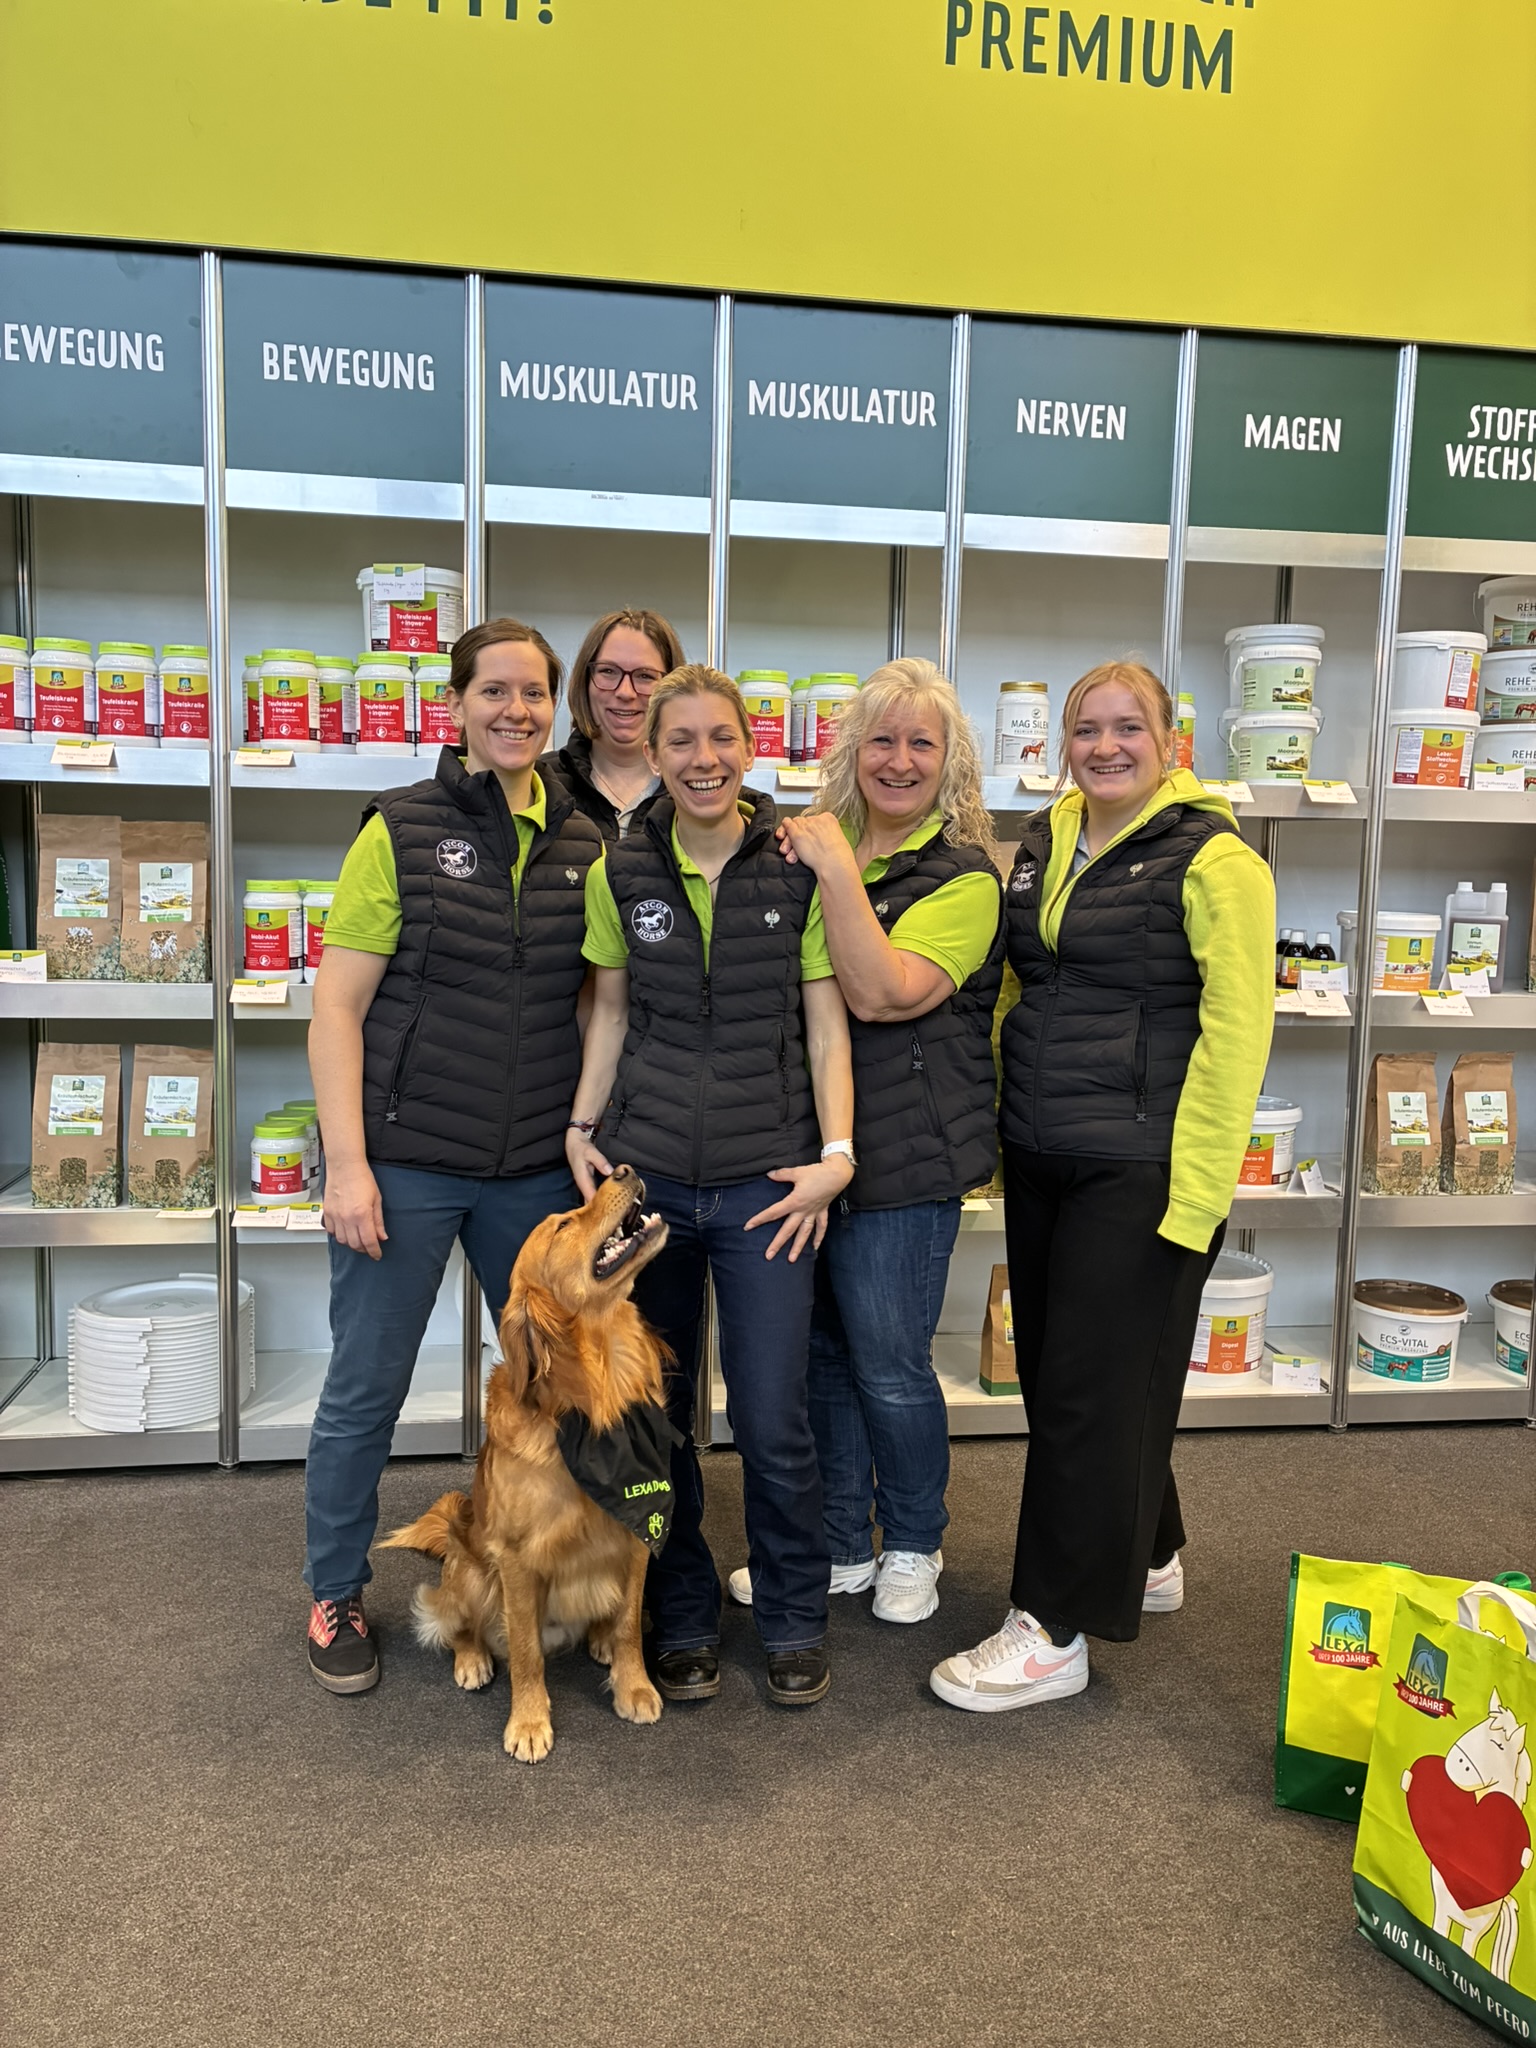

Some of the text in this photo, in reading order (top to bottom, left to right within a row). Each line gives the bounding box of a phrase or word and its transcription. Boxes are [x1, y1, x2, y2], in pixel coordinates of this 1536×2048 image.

[945, 0, 1233, 94] PREMIUM
[0, 323, 165, 372] EWEGUNG
[262, 342, 434, 391] BEWEGUNG
[500, 361, 698, 411] MUSKULATUR
[748, 379, 937, 428] MUSKULATUR
[1016, 399, 1127, 441] NERVEN
[1244, 414, 1341, 453] MAGEN
[1445, 443, 1536, 481] WECHS
[1517, 603, 1536, 612] REH
[396, 613, 432, 621] Teufelskralle
[40, 694, 78, 703] Teufelskralle
[102, 698, 138, 706] Teufelskralle
[168, 701, 205, 709] Teufelskralle
[267, 700, 303, 708] Teufelskralle
[1011, 719, 1030, 728] MAG
[441, 840, 471, 852] ATCOM
[443, 862, 472, 875] HORSE
[639, 901, 668, 914] ATCOM
[638, 927, 666, 940] HORSE
[1380, 1333, 1429, 1348] ECS-VITAL
[1514, 1330, 1530, 1342] ECS
[1326, 1636, 1365, 1653] LEXA
[1331, 1654, 1345, 1663] 100
[1345, 1654, 1371, 1664] JAHRE
[1408, 1672, 1438, 1698] LEXA
[1408, 1693, 1419, 1705] 100
[1418, 1696, 1444, 1713] JAHRE
[1383, 1921, 1530, 2039] AUS LIEBE ZUM PFERD
